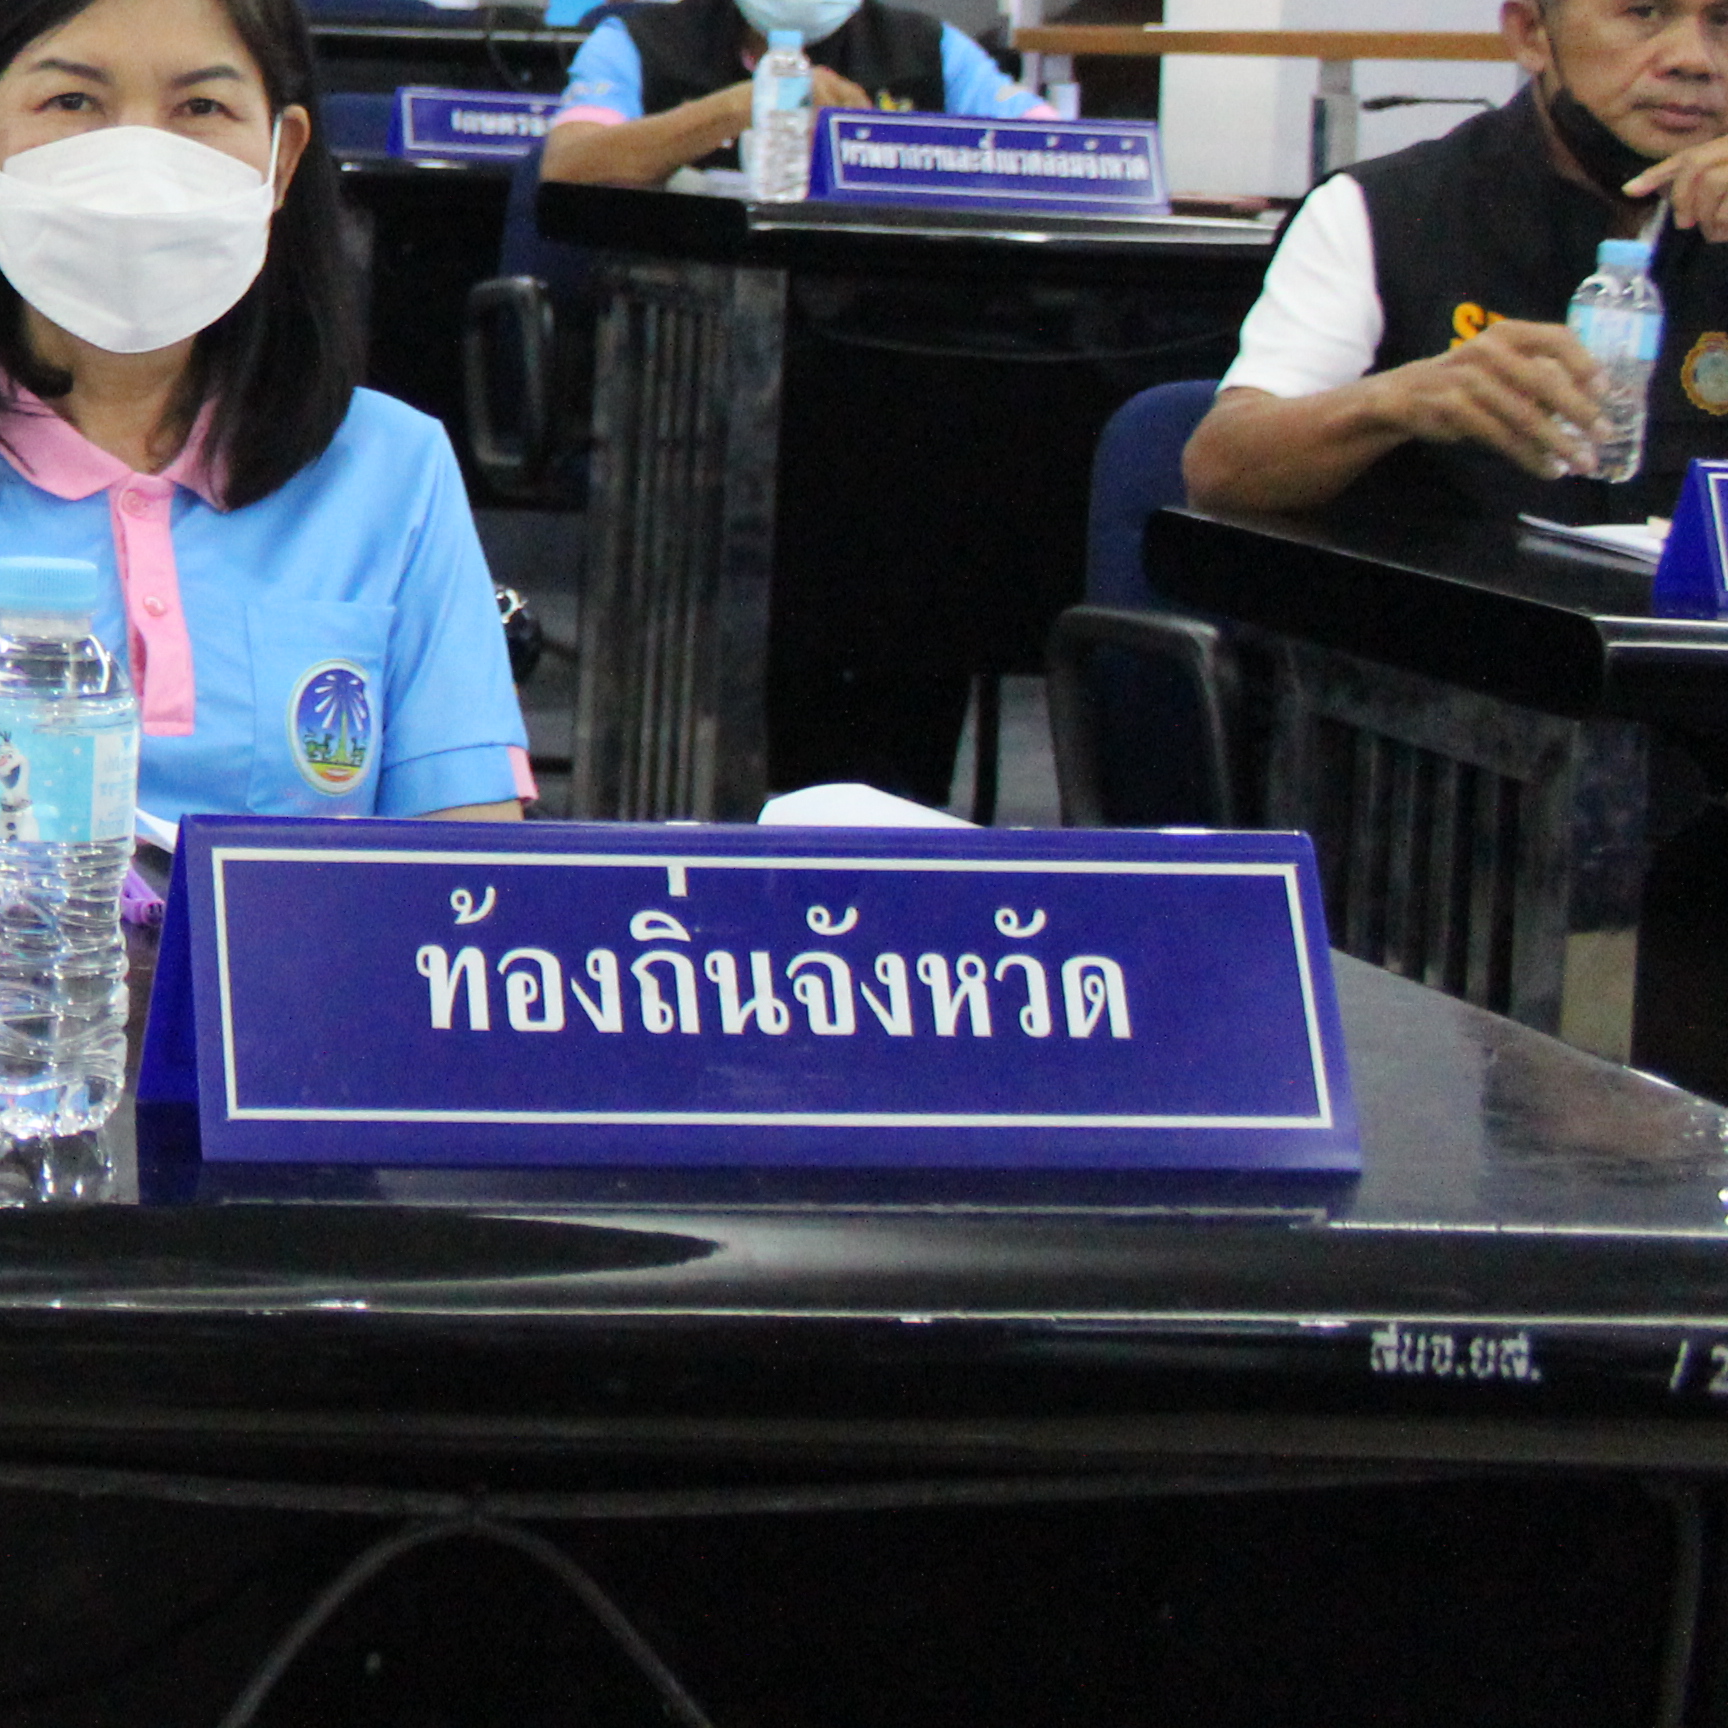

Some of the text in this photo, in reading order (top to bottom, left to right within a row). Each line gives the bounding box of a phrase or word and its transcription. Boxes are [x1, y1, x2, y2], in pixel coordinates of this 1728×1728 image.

[415, 866, 1134, 1040] ท้องถิ่นจังหวัด
